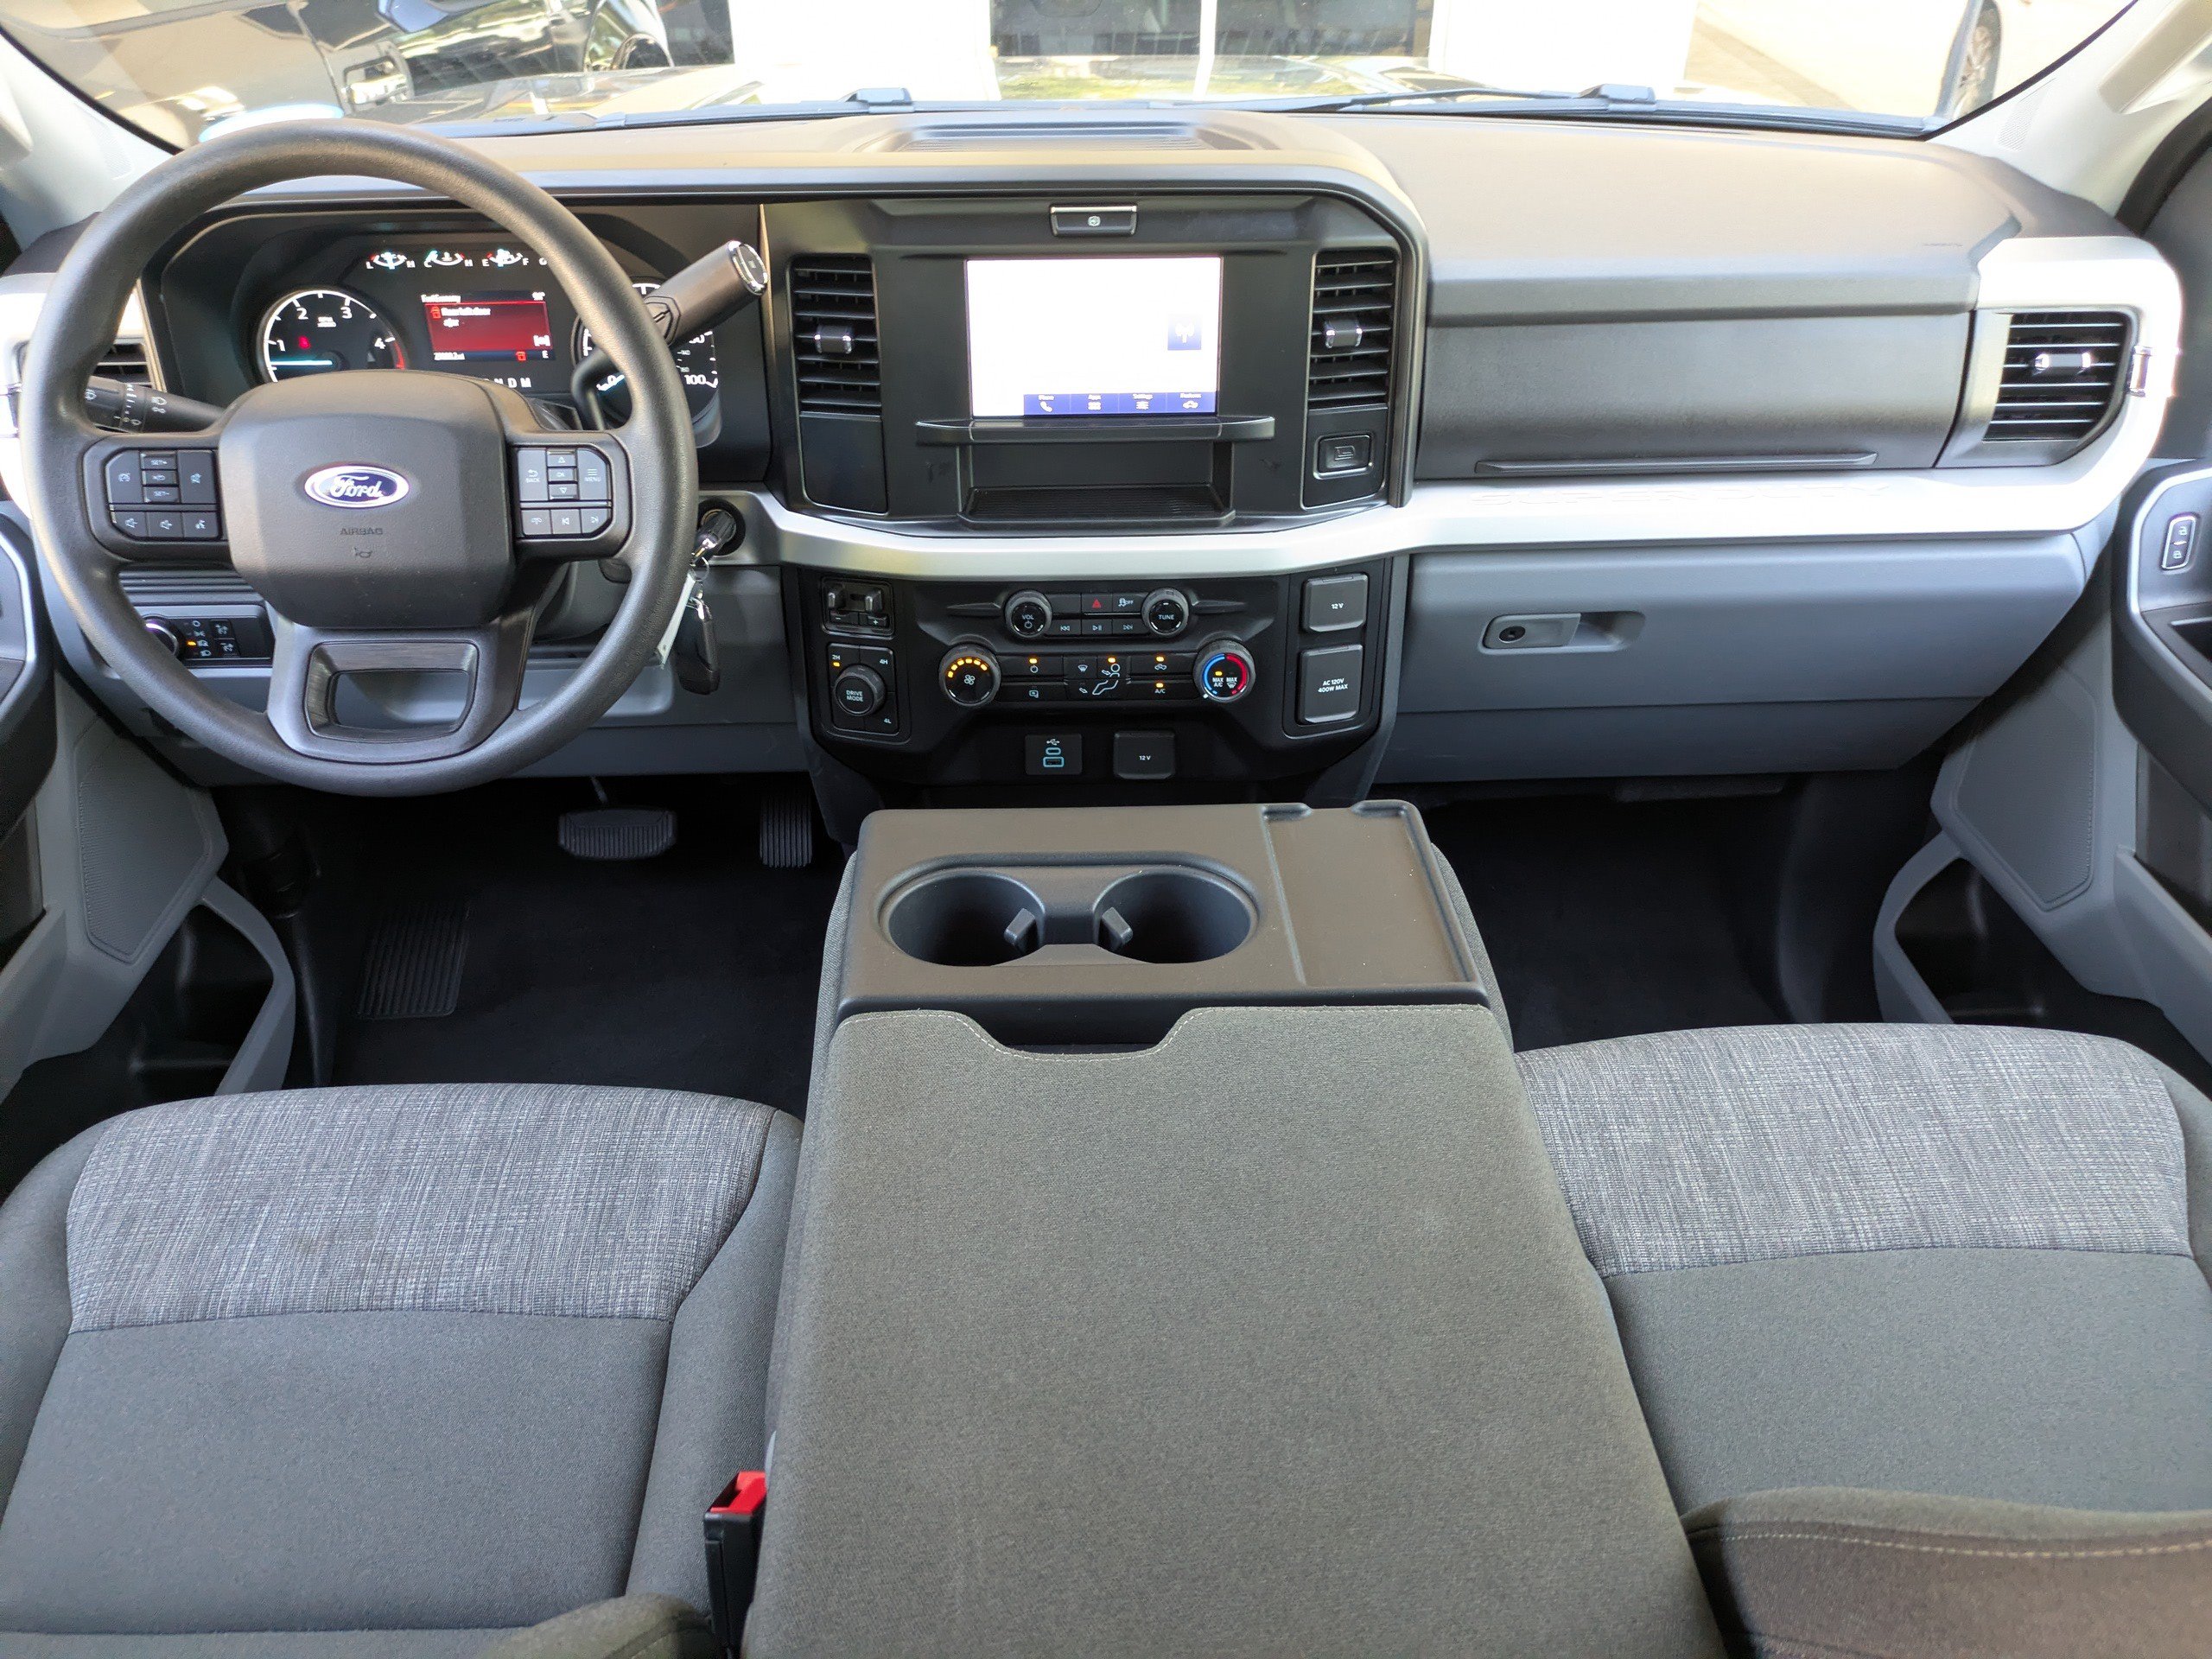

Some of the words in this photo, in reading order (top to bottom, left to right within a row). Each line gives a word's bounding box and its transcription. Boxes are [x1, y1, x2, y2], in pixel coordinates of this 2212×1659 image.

[296, 308, 308, 320] 2
[340, 306, 353, 319] 3
[276, 340, 286, 352] 1
[374, 337, 386, 349] 4
[507, 377, 518, 389] D
[683, 374, 707, 385] 100
[340, 527, 384, 536] AIRBAG
